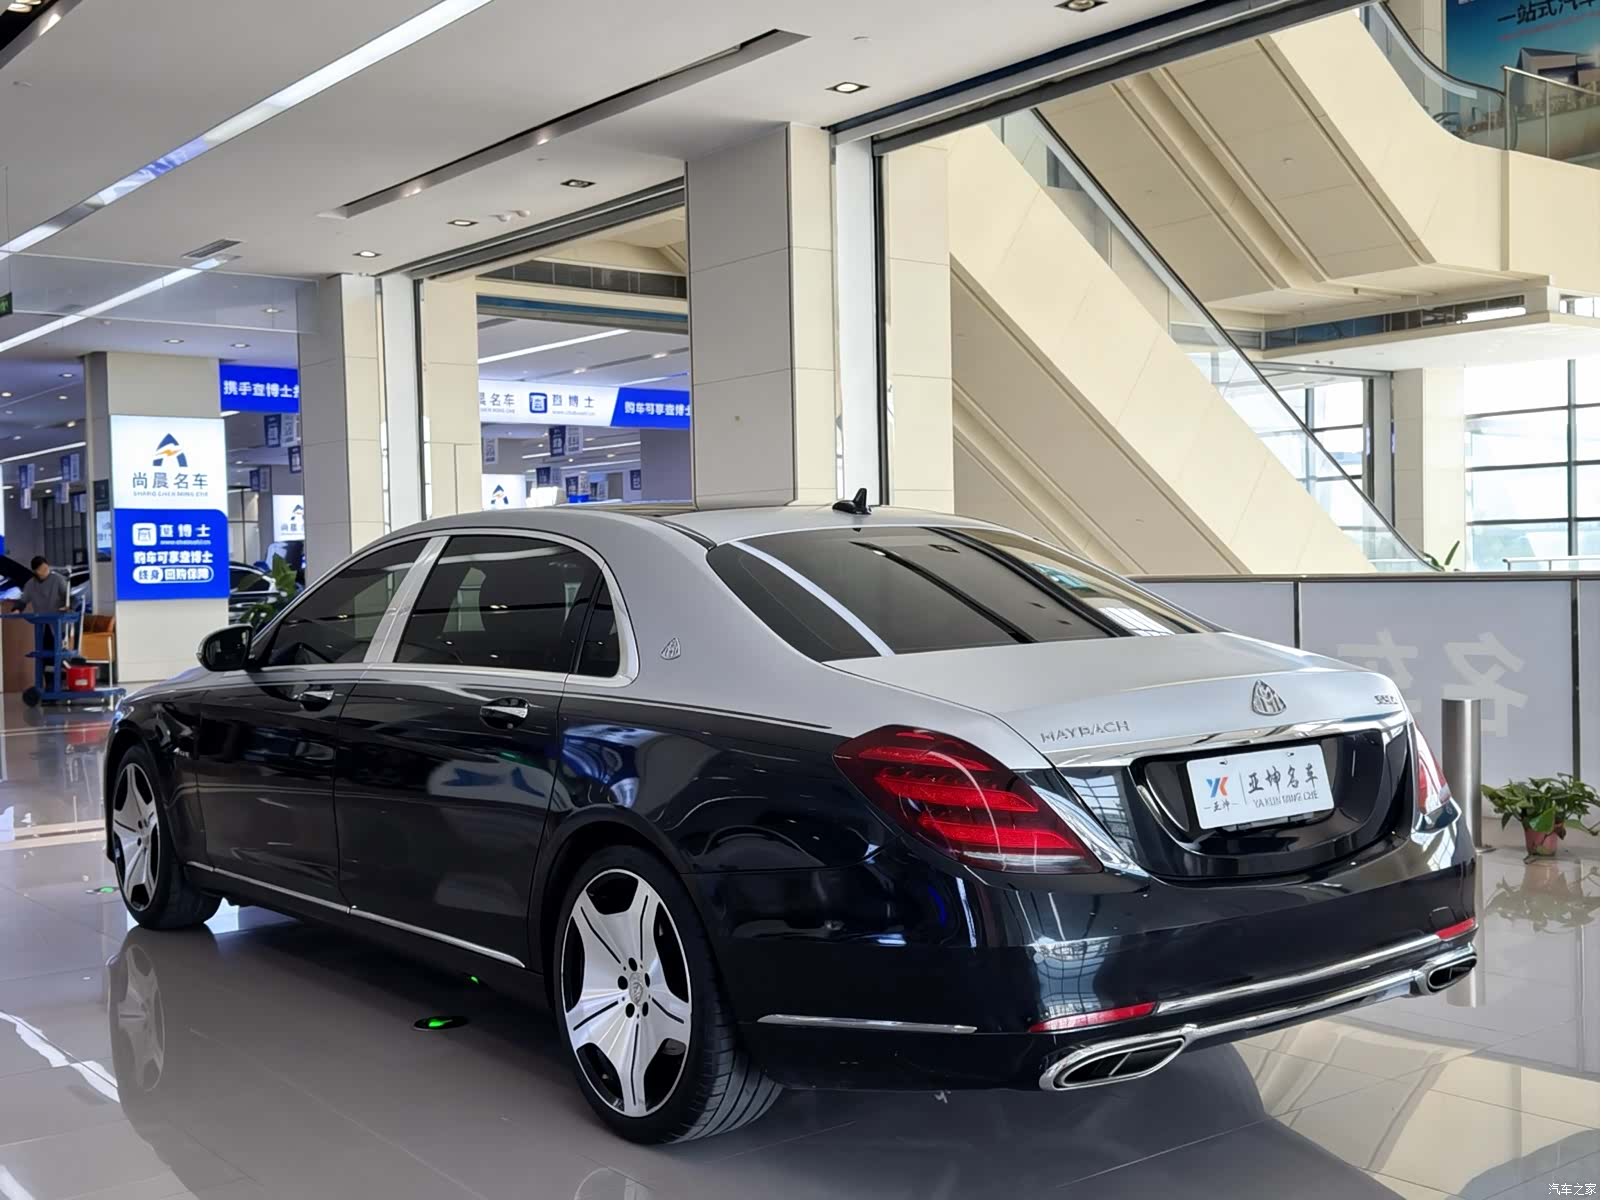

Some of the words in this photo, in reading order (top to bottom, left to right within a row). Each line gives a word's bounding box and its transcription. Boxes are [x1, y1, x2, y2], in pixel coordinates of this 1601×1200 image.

[132, 471, 208, 489] 尚晨名车
[1040, 720, 1130, 743] MAYBACH
